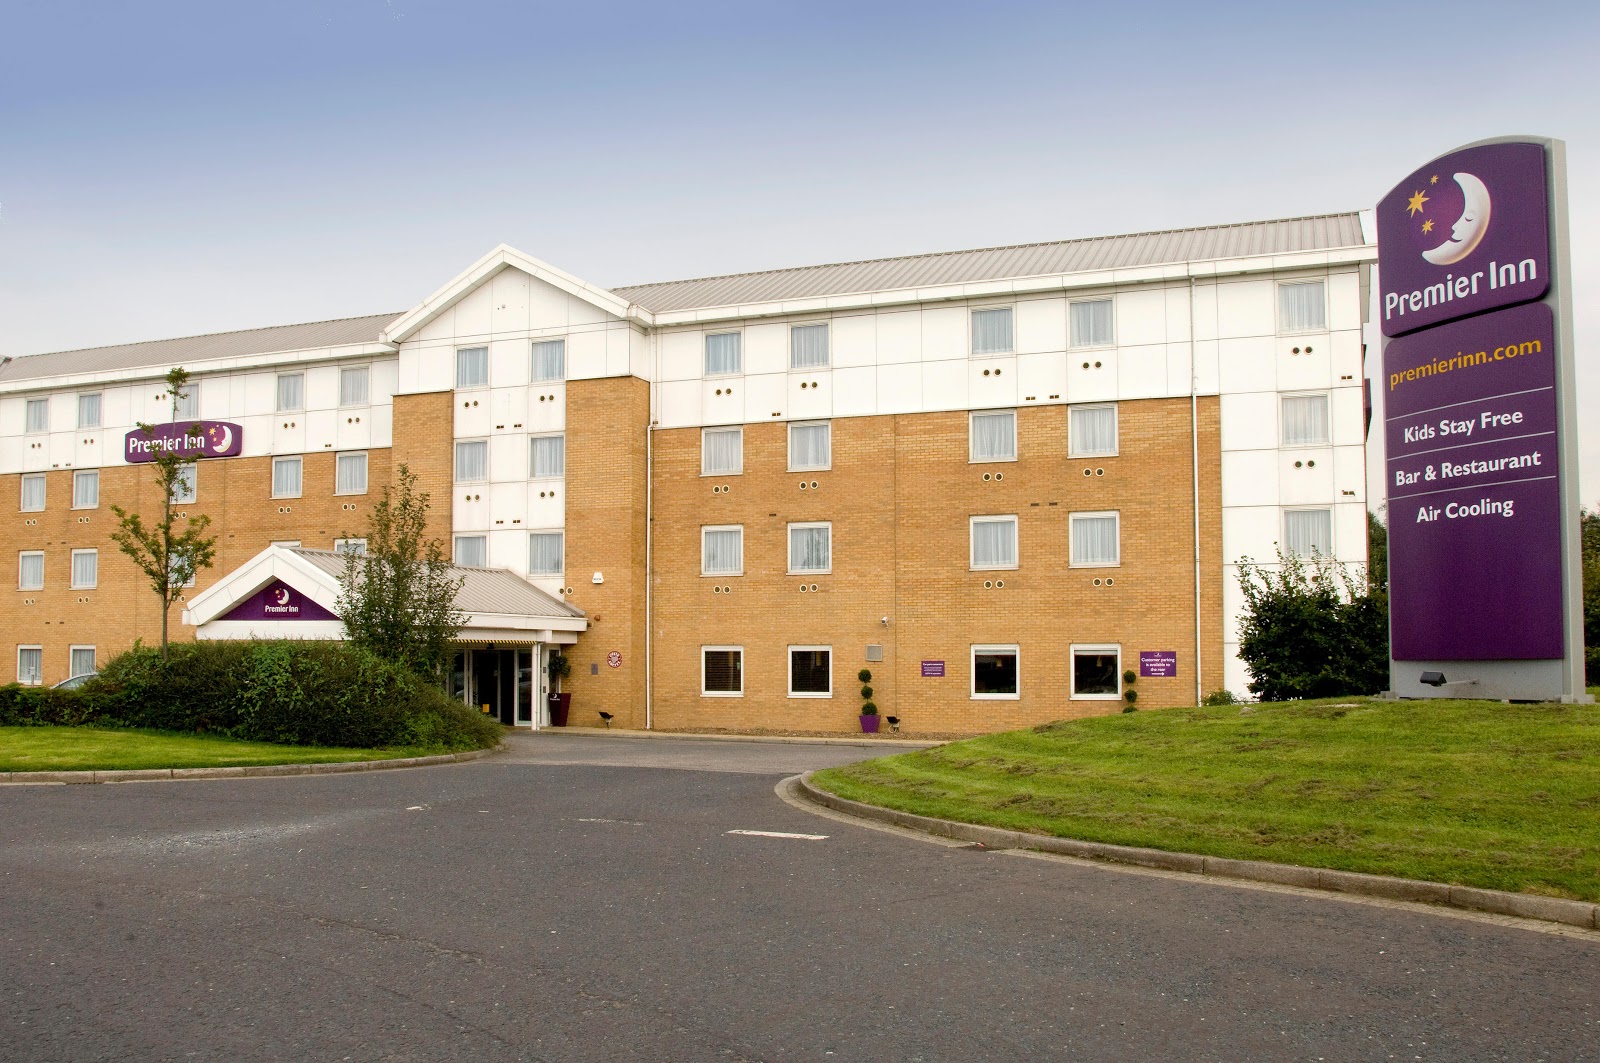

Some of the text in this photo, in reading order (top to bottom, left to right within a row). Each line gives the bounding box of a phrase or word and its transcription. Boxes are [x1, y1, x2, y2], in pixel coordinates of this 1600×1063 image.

[1385, 258, 1537, 320] Premier Inn
[1390, 339, 1542, 391] premierinn.com
[184, 433, 205, 450] Inn
[1404, 411, 1523, 443] Kids Stay Free
[1395, 450, 1542, 487] Bar & Restaurant
[1416, 497, 1514, 523] Air Cooling
[265, 605, 298, 613] Premier Inn
